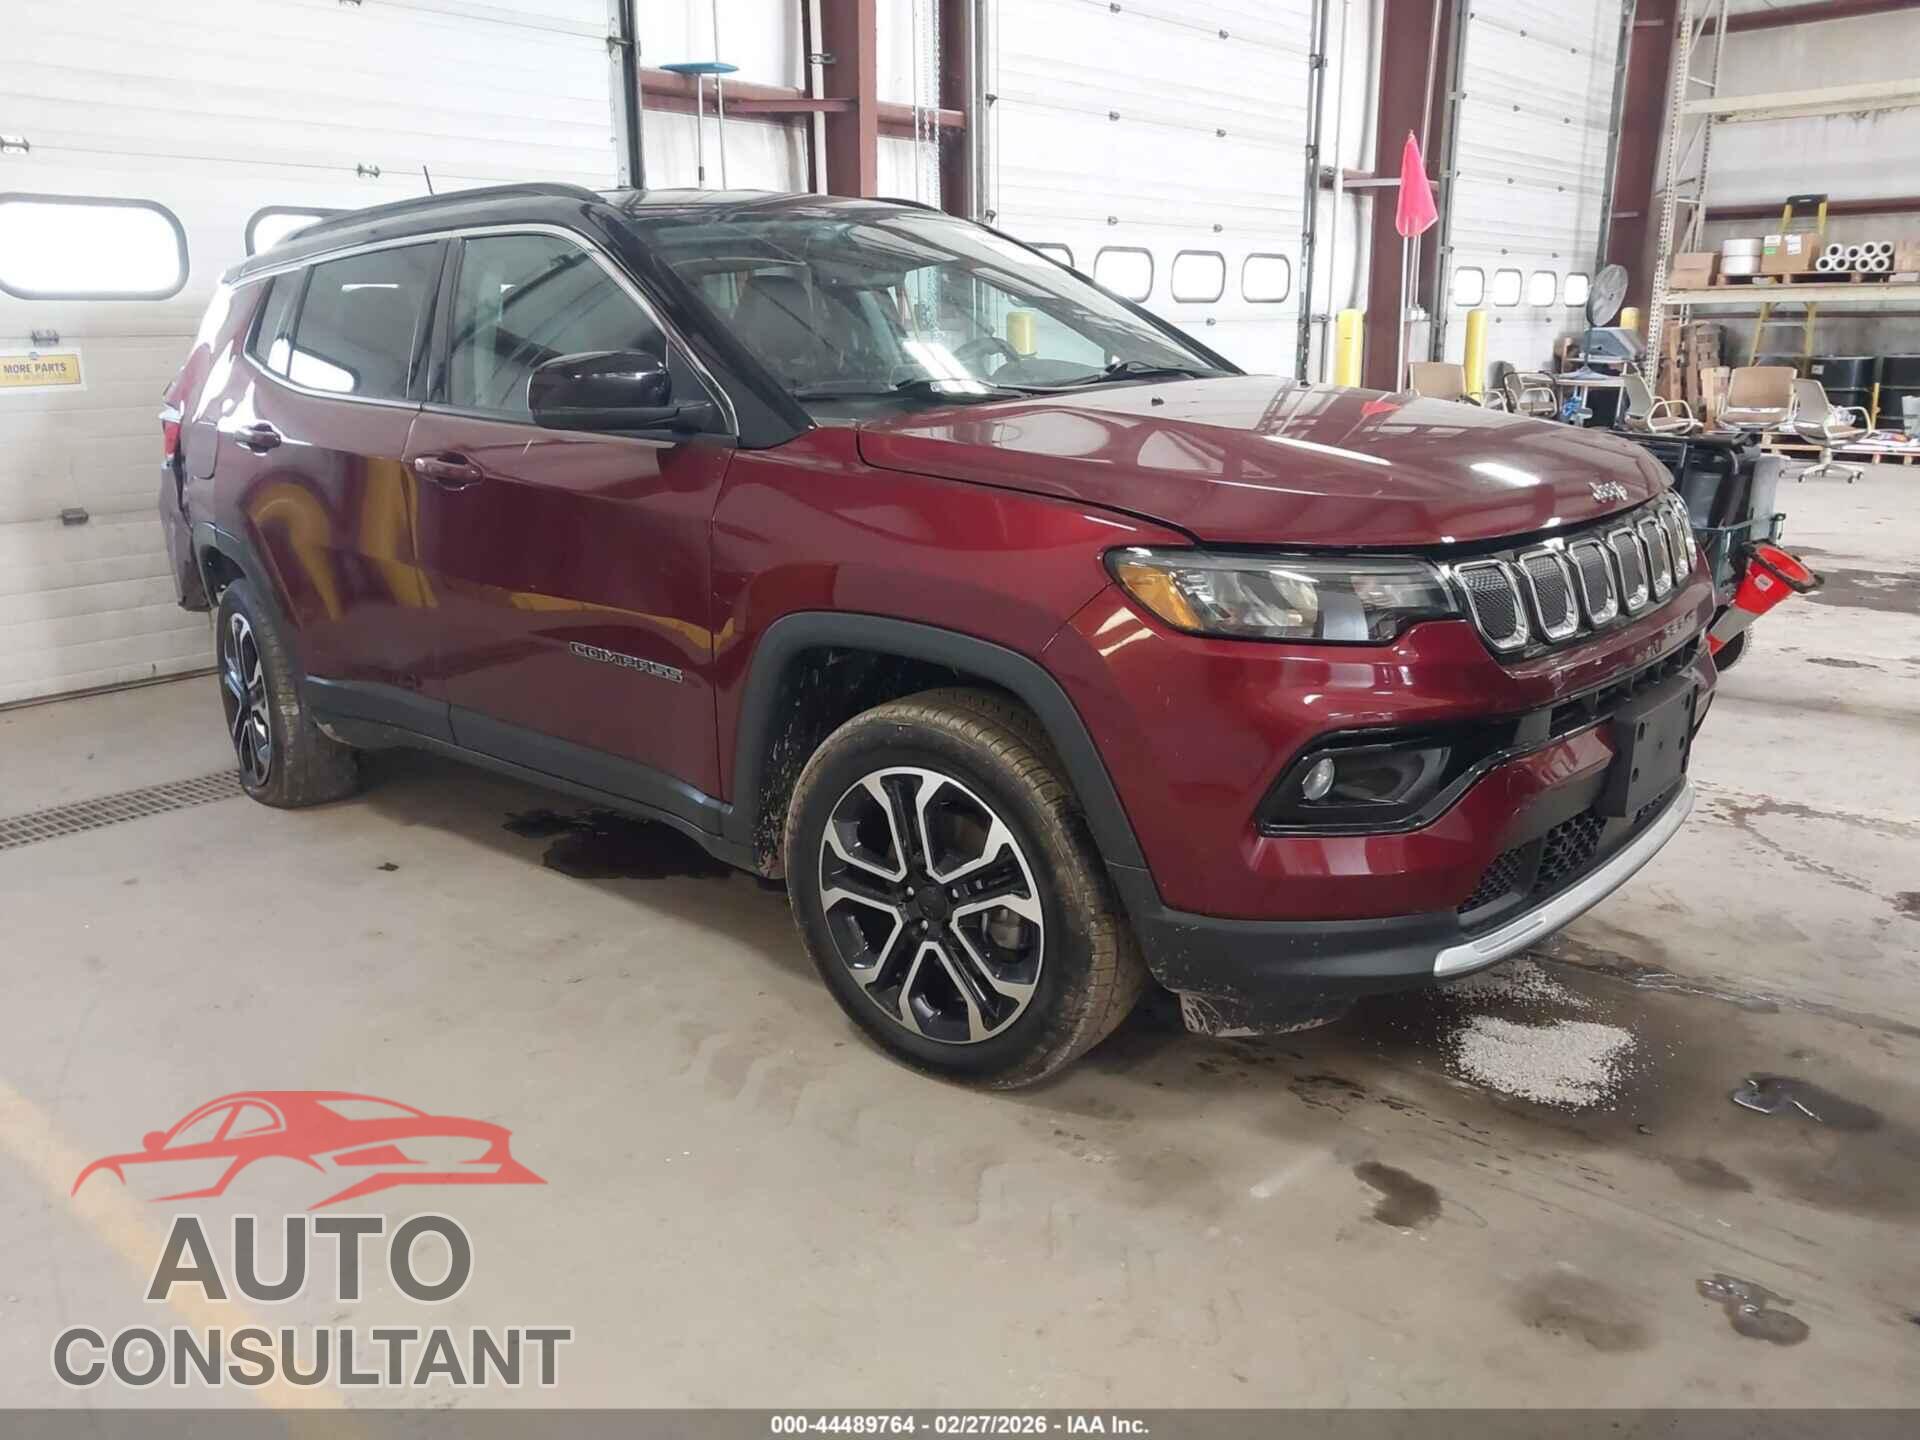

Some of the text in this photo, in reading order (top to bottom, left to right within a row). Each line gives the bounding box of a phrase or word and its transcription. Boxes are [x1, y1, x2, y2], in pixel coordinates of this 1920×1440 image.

[4, 362, 66, 374] MORE PARTS
[569, 641, 683, 683] COMPASS
